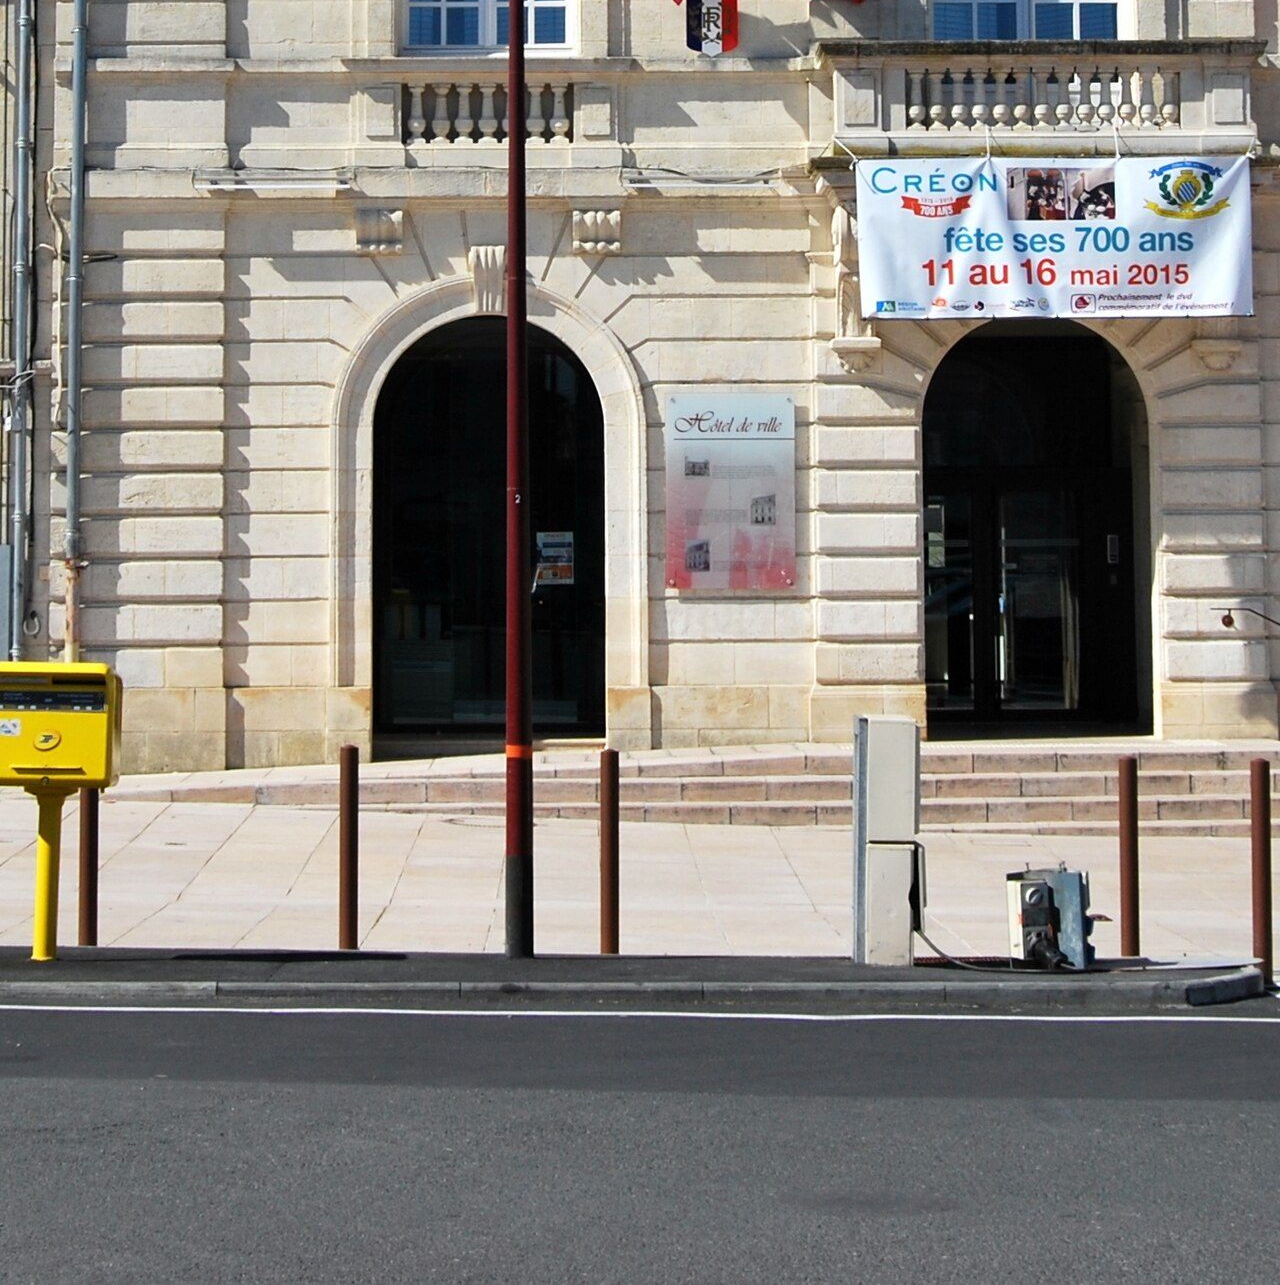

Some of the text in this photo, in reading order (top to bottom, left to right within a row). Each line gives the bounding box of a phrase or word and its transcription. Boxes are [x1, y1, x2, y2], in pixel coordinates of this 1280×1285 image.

[871, 167, 998, 194] CRÉON
[920, 204, 953, 216] 700 ANS
[944, 226, 1194, 253] fête ses 700 ans
[922, 258, 1190, 286] 11 au 16 mai 2015
[1098, 293, 1163, 301] Prochainement
[674, 411, 782, 433] Hôtel de ville
[515, 494, 521, 504] 2
